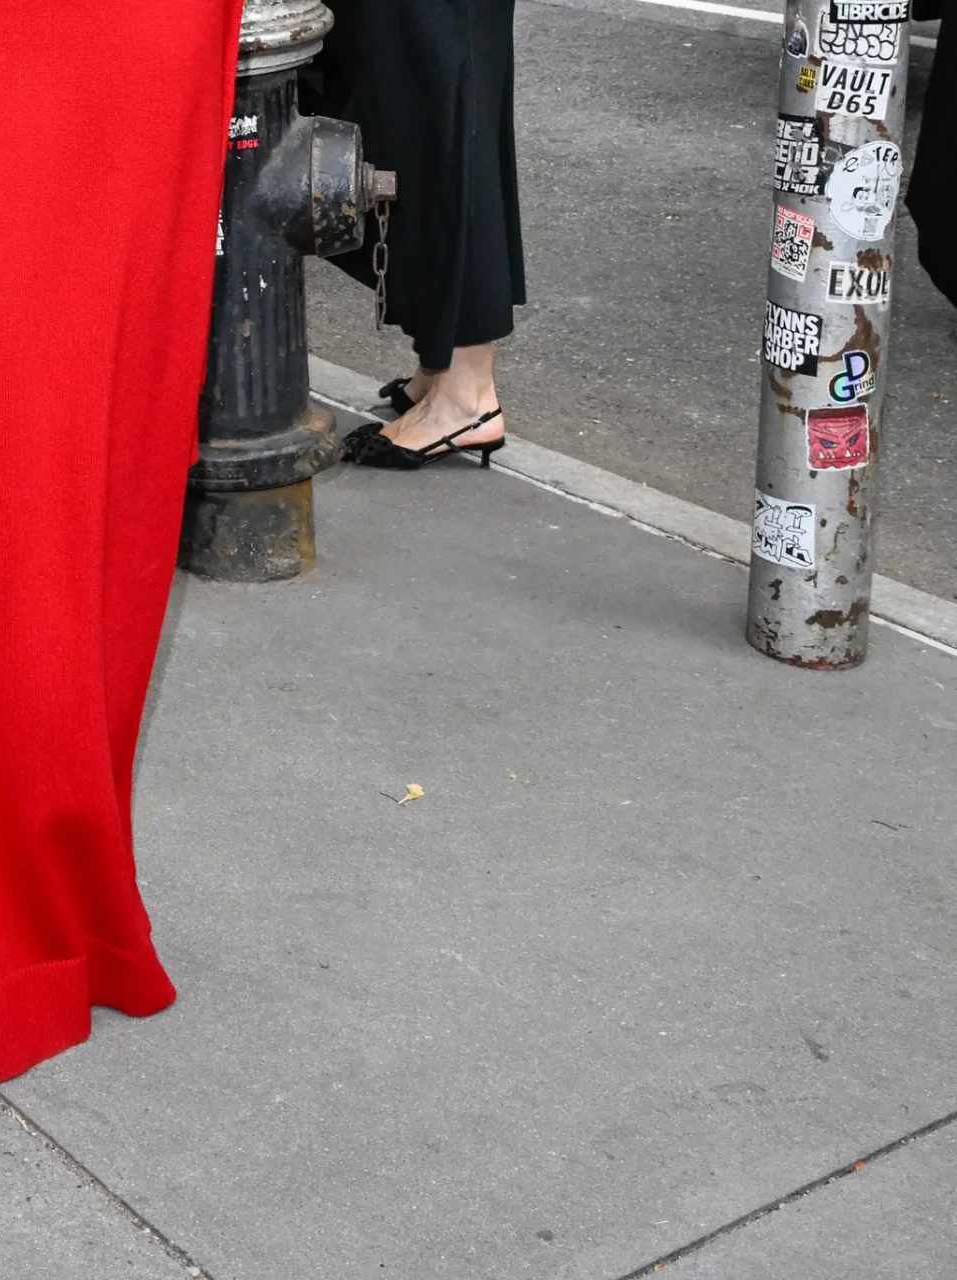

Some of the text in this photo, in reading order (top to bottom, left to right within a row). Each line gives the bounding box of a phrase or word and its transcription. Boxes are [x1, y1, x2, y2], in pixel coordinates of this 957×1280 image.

[822, 64, 890, 95] VAULT
[827, 91, 877, 115] D65
[765, 340, 805, 371] SHOP
